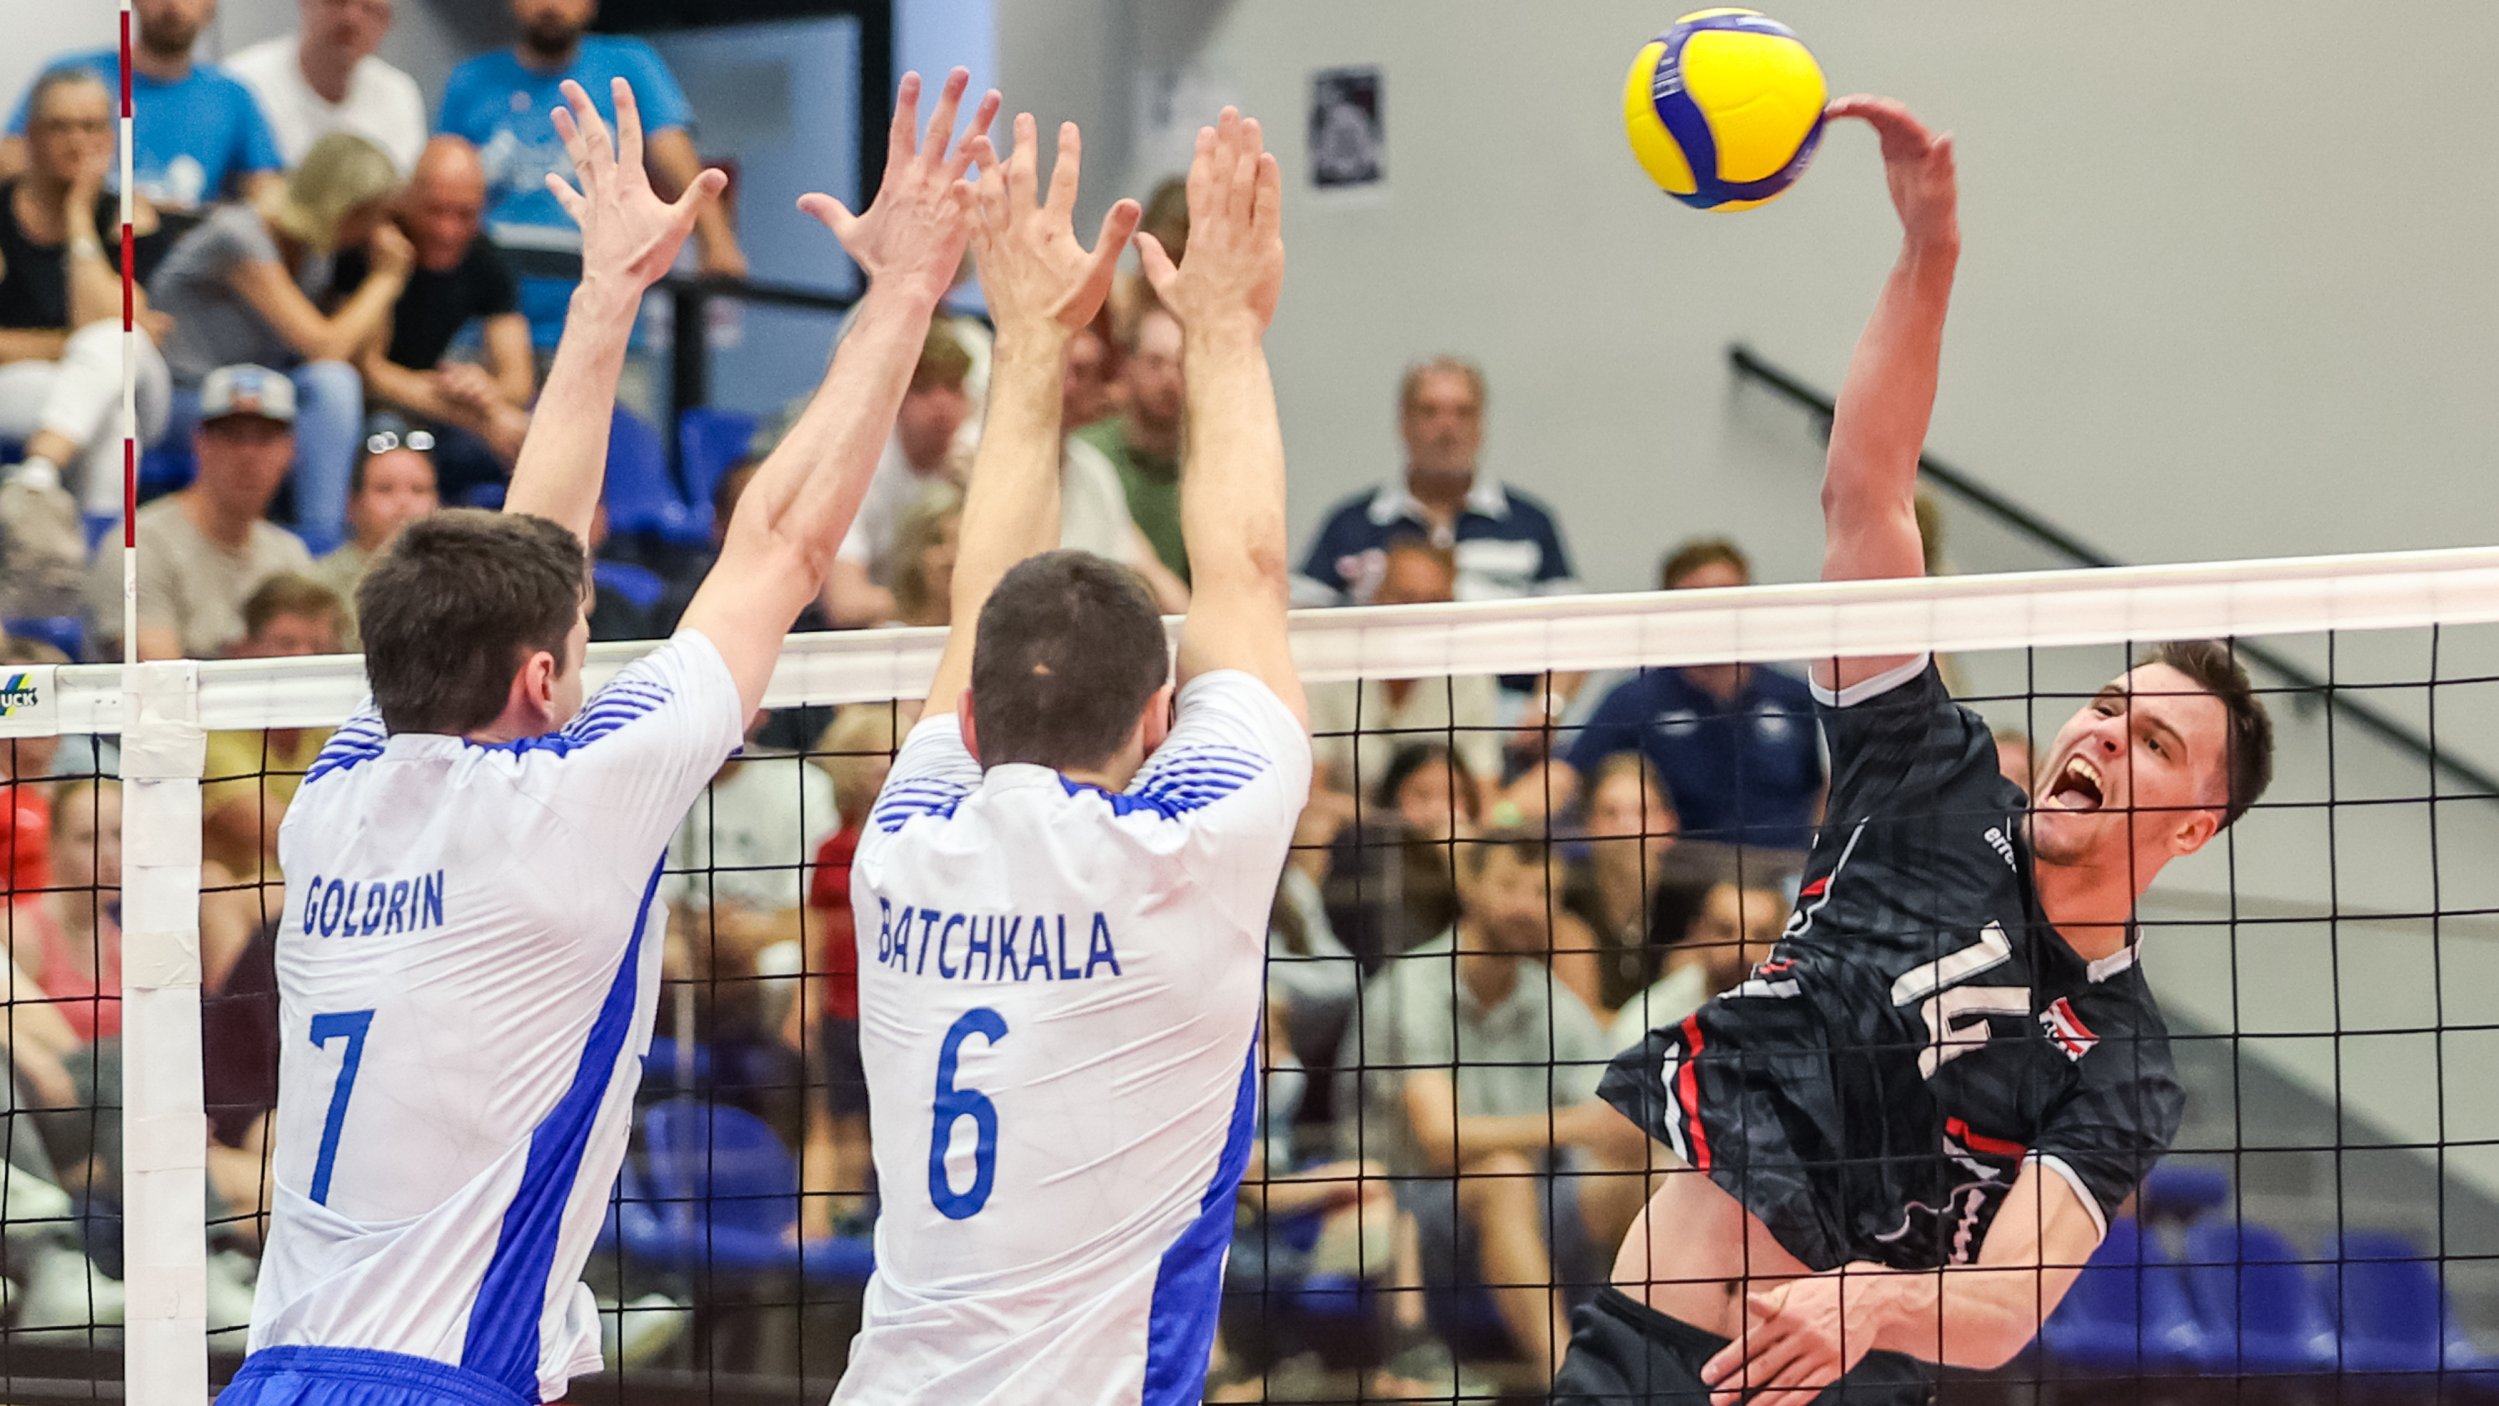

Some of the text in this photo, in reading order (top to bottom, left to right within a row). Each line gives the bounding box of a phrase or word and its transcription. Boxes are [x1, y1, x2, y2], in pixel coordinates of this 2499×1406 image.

[303, 868, 444, 938] GOLDRIN
[878, 896, 1122, 981] BATCHKALA
[309, 1009, 376, 1207] 7
[929, 1007, 1009, 1220] 6
